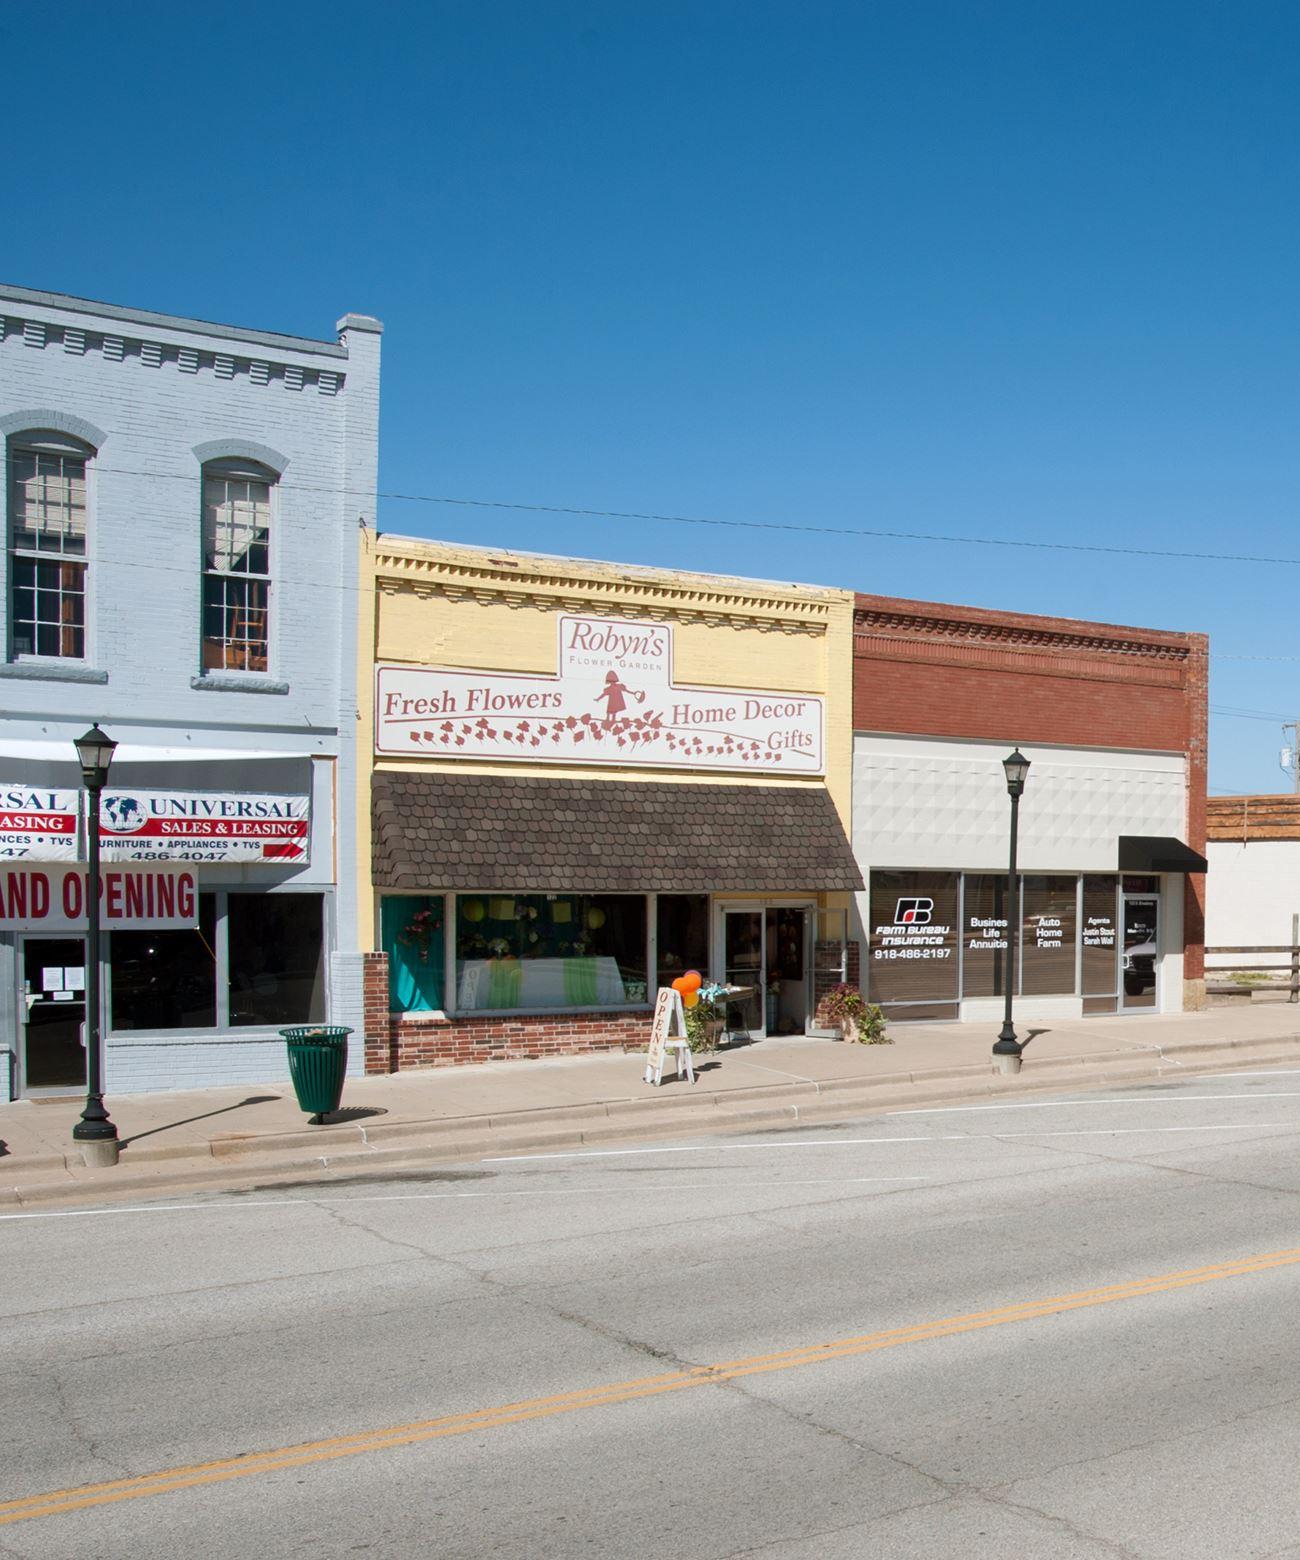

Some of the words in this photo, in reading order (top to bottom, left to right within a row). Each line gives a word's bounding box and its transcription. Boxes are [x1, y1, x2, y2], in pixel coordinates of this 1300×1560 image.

[568, 622, 664, 659] Robyn's
[383, 690, 457, 716] Fresh
[465, 688, 563, 712] Flowers
[671, 704, 737, 725] Home
[743, 700, 807, 721] Decor
[767, 729, 813, 750] Gifts
[150, 799, 300, 818] UNIVERSAL
[161, 822, 211, 834] SALES
[216, 823, 228, 834] &
[233, 823, 298, 835] LEASING
[50, 837, 73, 845] TVS
[100, 840, 152, 848] URNITURE
[131, 852, 228, 860] 486-4047
[970, 917, 1008, 927] Busines
[1038, 918, 1061, 927] Auto
[983, 928, 1000, 938] Life
[1036, 928, 1062, 937] Home
[969, 939, 1008, 949] Annuitie
[1037, 938, 1061, 948] Farm
[874, 949, 951, 959] 918-486-2197
[651, 991, 669, 1043] OPEN
